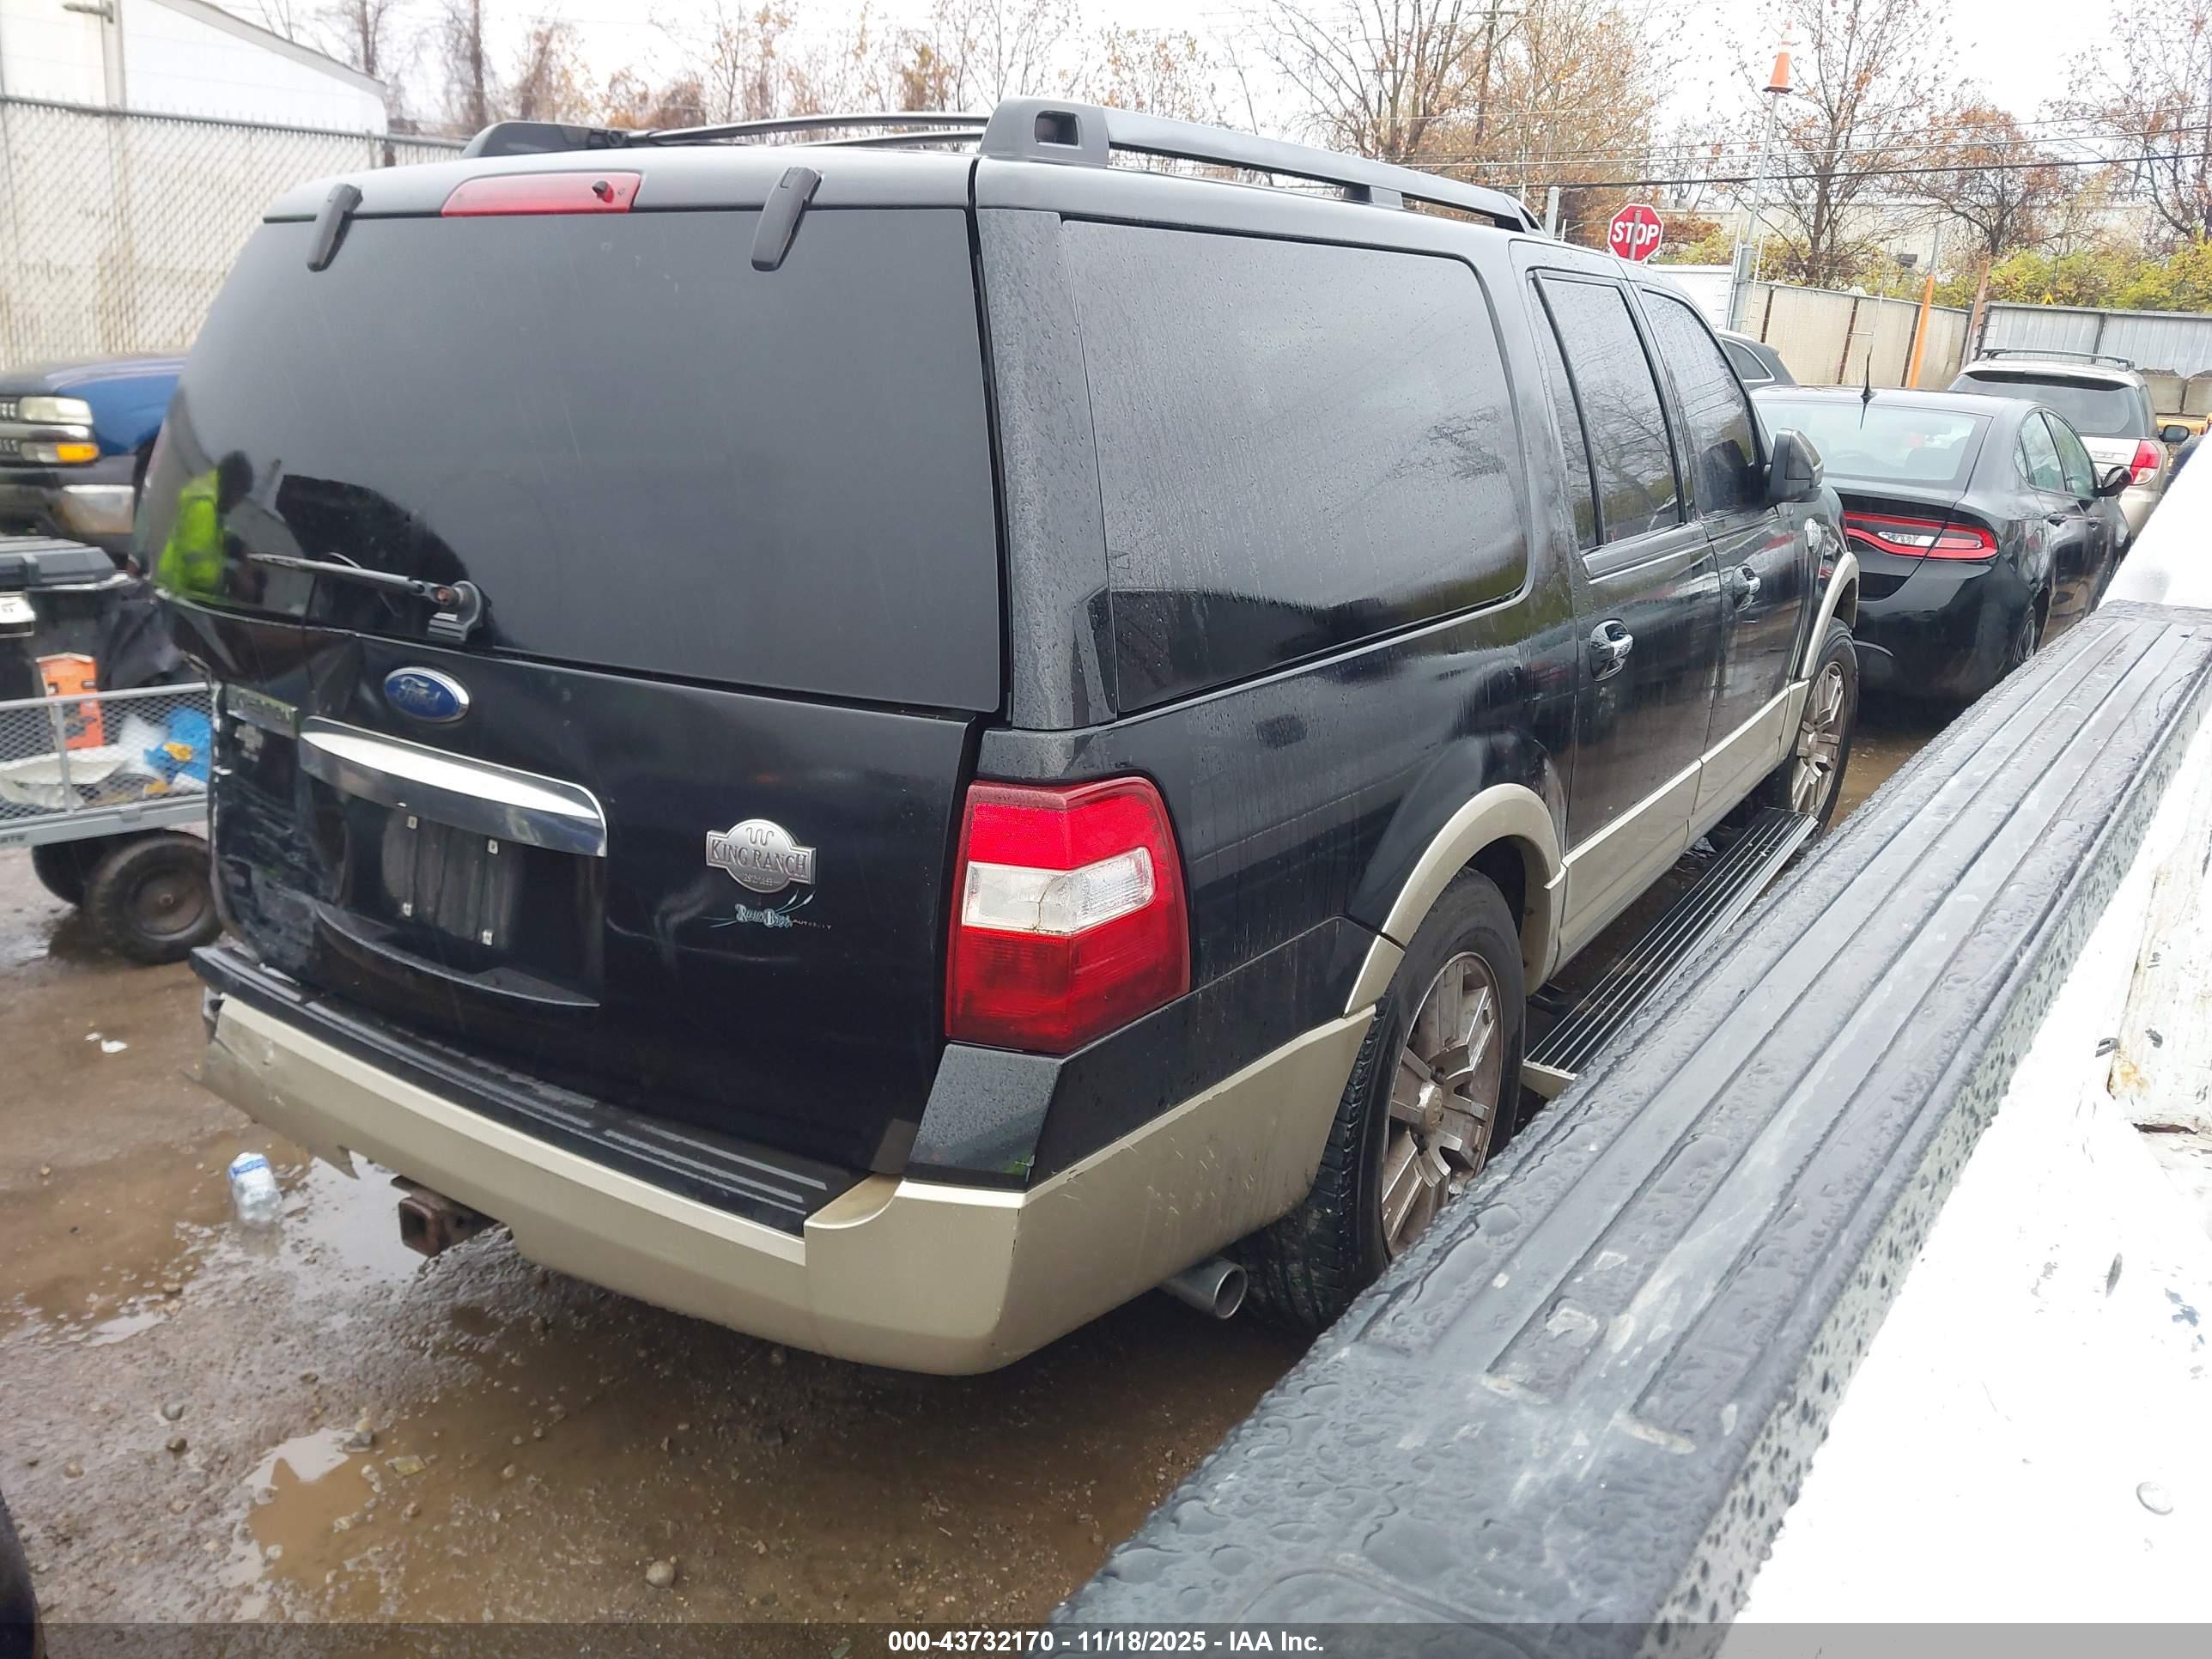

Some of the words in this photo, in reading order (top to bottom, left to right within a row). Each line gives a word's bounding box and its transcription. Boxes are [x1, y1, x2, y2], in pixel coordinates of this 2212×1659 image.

[1612, 221, 1660, 246] STOP
[711, 838, 748, 867] KING
[751, 848, 808, 878] RANCH
